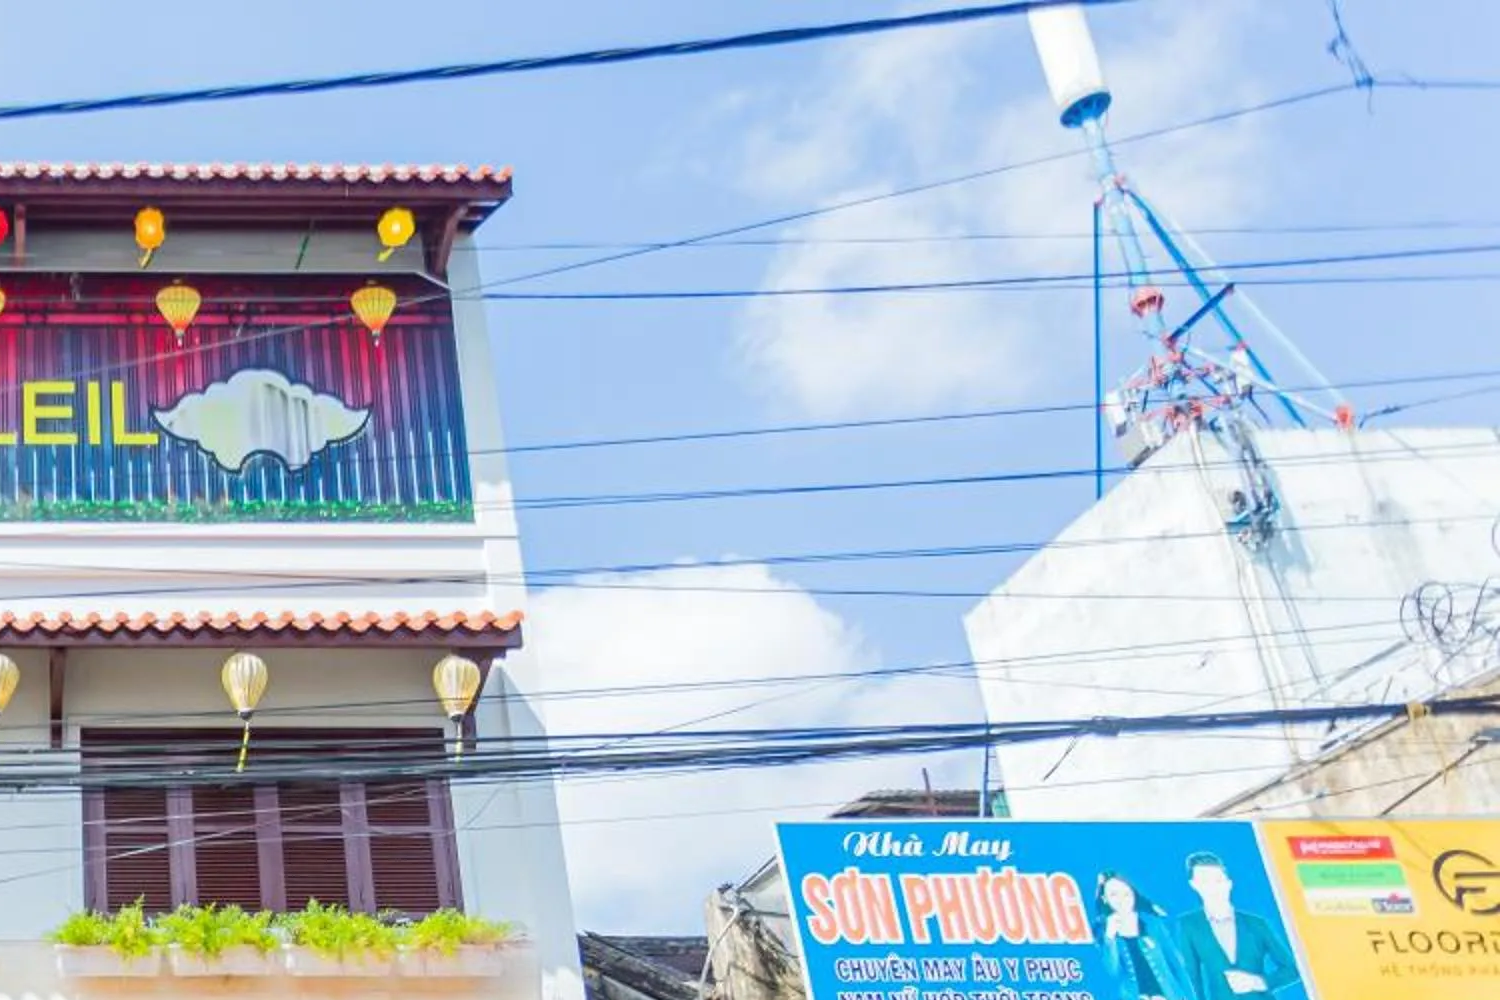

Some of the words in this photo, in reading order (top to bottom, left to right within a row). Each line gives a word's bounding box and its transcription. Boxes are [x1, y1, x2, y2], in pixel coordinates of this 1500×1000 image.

[843, 831, 926, 857] Nhà
[932, 831, 1013, 861] May
[802, 867, 904, 944] SƠN
[900, 867, 1093, 944] PHƯƠNG
[836, 952, 920, 982] CHUYÊN
[922, 958, 966, 982] MAY
[1005, 958, 1019, 981] Y
[1024, 958, 1084, 986] PHỤC
